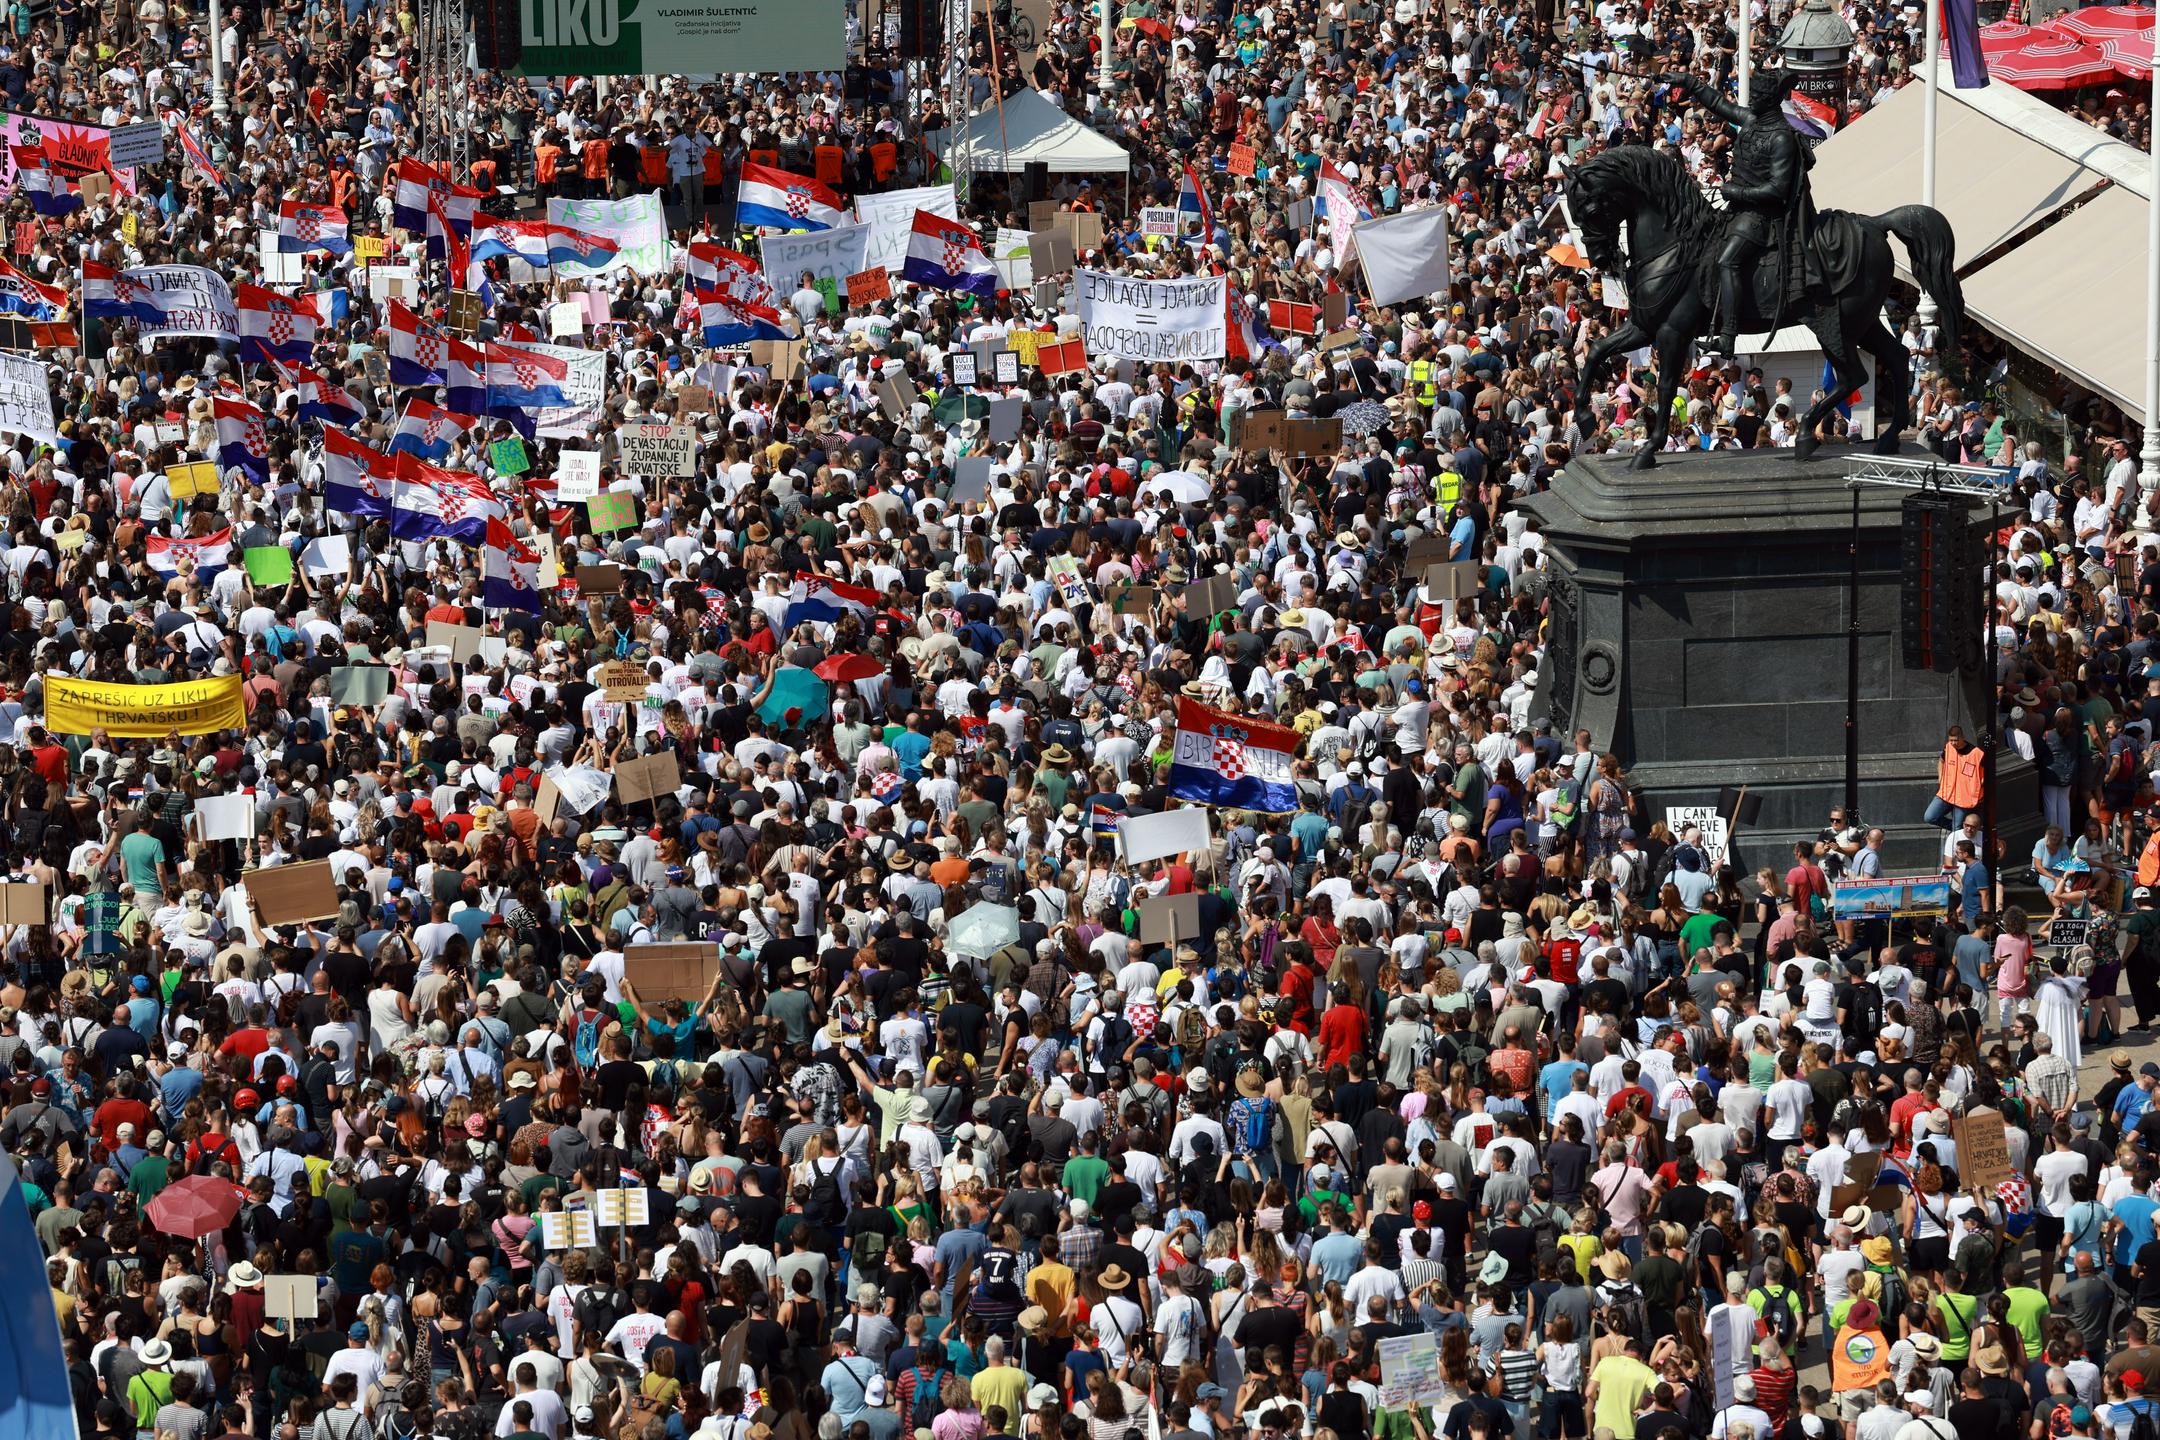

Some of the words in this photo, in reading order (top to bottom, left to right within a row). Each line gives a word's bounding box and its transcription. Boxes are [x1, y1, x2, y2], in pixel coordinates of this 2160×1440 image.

[657, 9, 704, 17] VLADIMIR
[706, 7, 758, 16] ŠULETNTIĆ
[521, 0, 619, 46] LIKU
[59, 143, 99, 168] GLADNI?
[1147, 211, 1174, 222] POSTAJEM
[363, 238, 382, 252] LIKO
[956, 373, 975, 381] SKUPA!
[640, 426, 671, 437] STOP
[623, 437, 689, 451] DEVASTACIJI
[631, 451, 679, 463] ŽUPANIJE
[683, 453, 687, 463] I
[628, 463, 681, 476] HRVATSKE
[564, 472, 574, 481] STE
[575, 472, 591, 481] NAS!
[1442, 481, 1459, 489] REDAR
[622, 661, 635, 669] ŠTO
[60, 689, 136, 707] ZAPREŠIĆ
[144, 694, 164, 706] UZ
[173, 688, 208, 704] LIKU
[97, 711, 100, 723] I
[105, 709, 187, 724] HRVATSKU
[1323, 736, 1344, 745] BORN
[1673, 808, 1677, 819] I
[1684, 808, 1715, 819] CAN'T
[1709, 847, 1723, 859] TO
[1983, 1159, 1995, 1168] ZA
[991, 1257, 1003, 1276] 7
[626, 1325, 646, 1335] DOSTA
[648, 1325, 655, 1334] JE
[1851, 1368, 1880, 1379] STUPNIK
